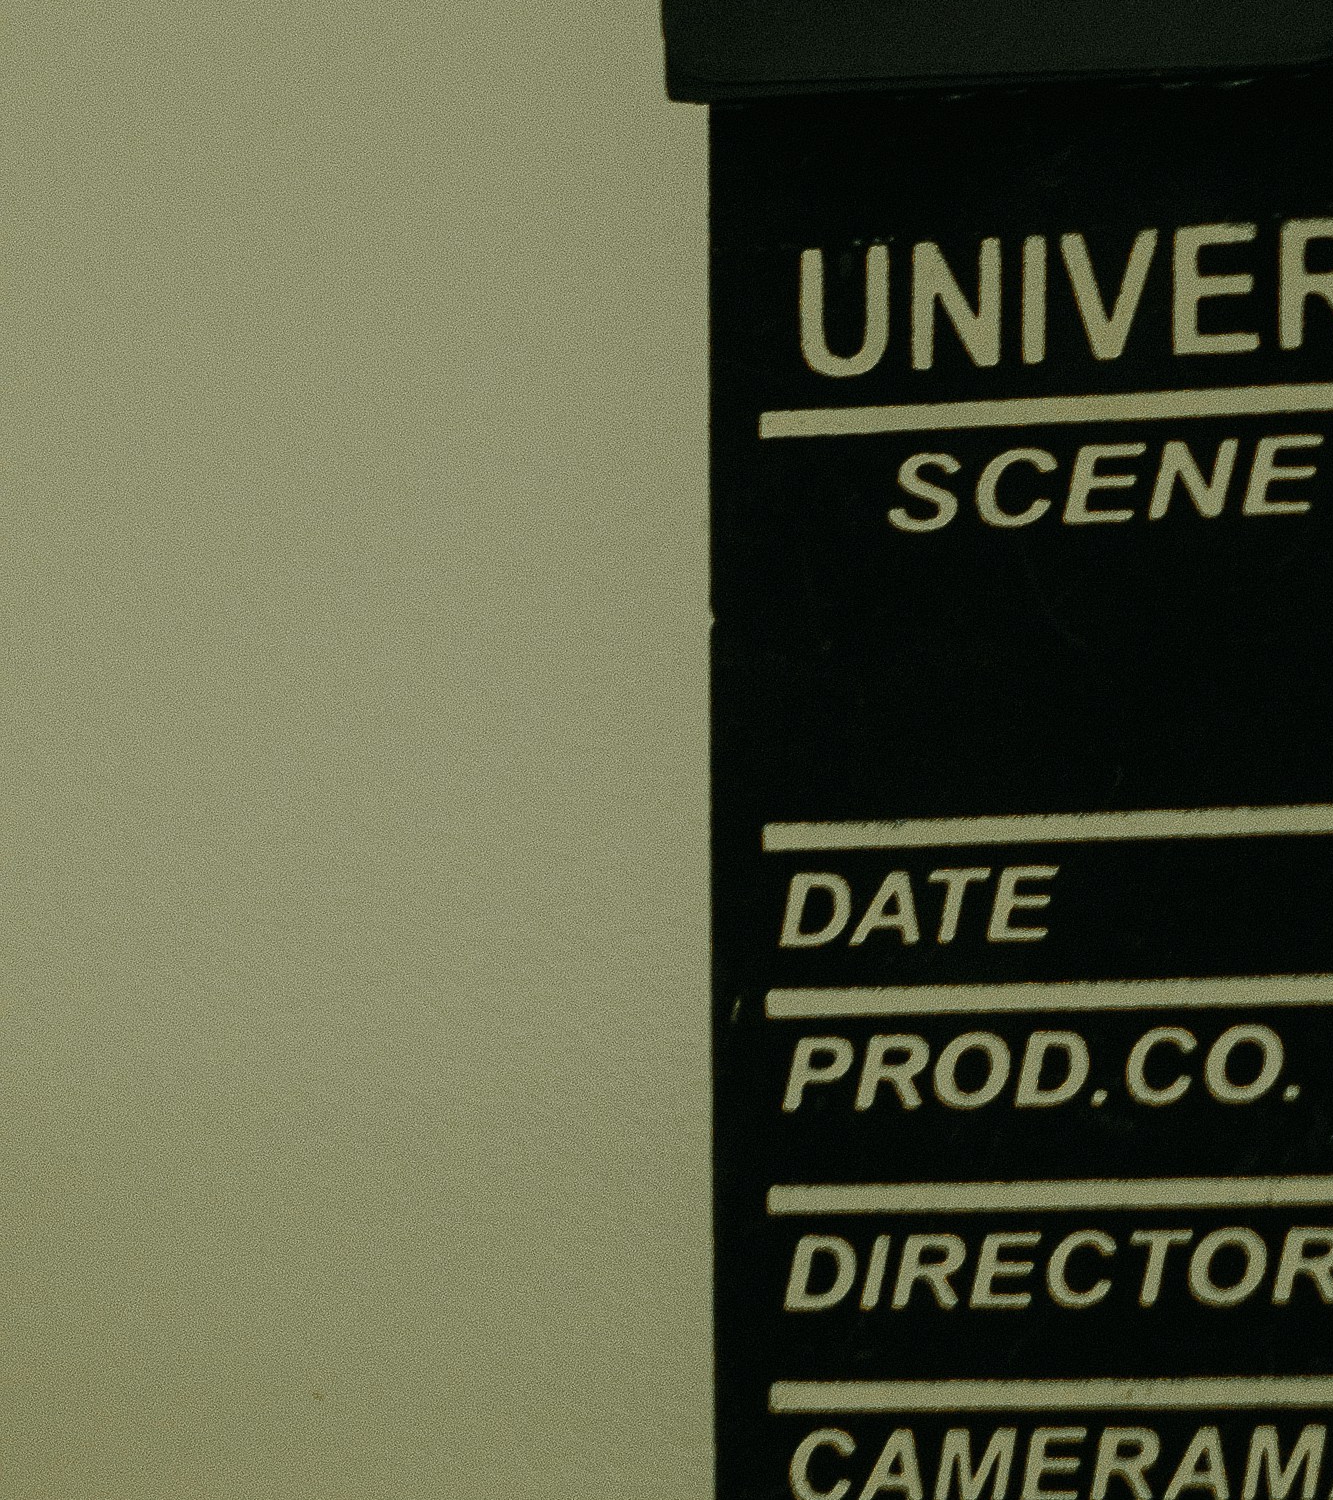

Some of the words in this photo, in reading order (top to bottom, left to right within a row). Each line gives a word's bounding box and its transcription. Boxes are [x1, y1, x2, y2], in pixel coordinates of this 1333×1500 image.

[886, 432, 1325, 534] SCENE
[777, 864, 1061, 949] DATE
[781, 1022, 1303, 1114] PROD.CO.
